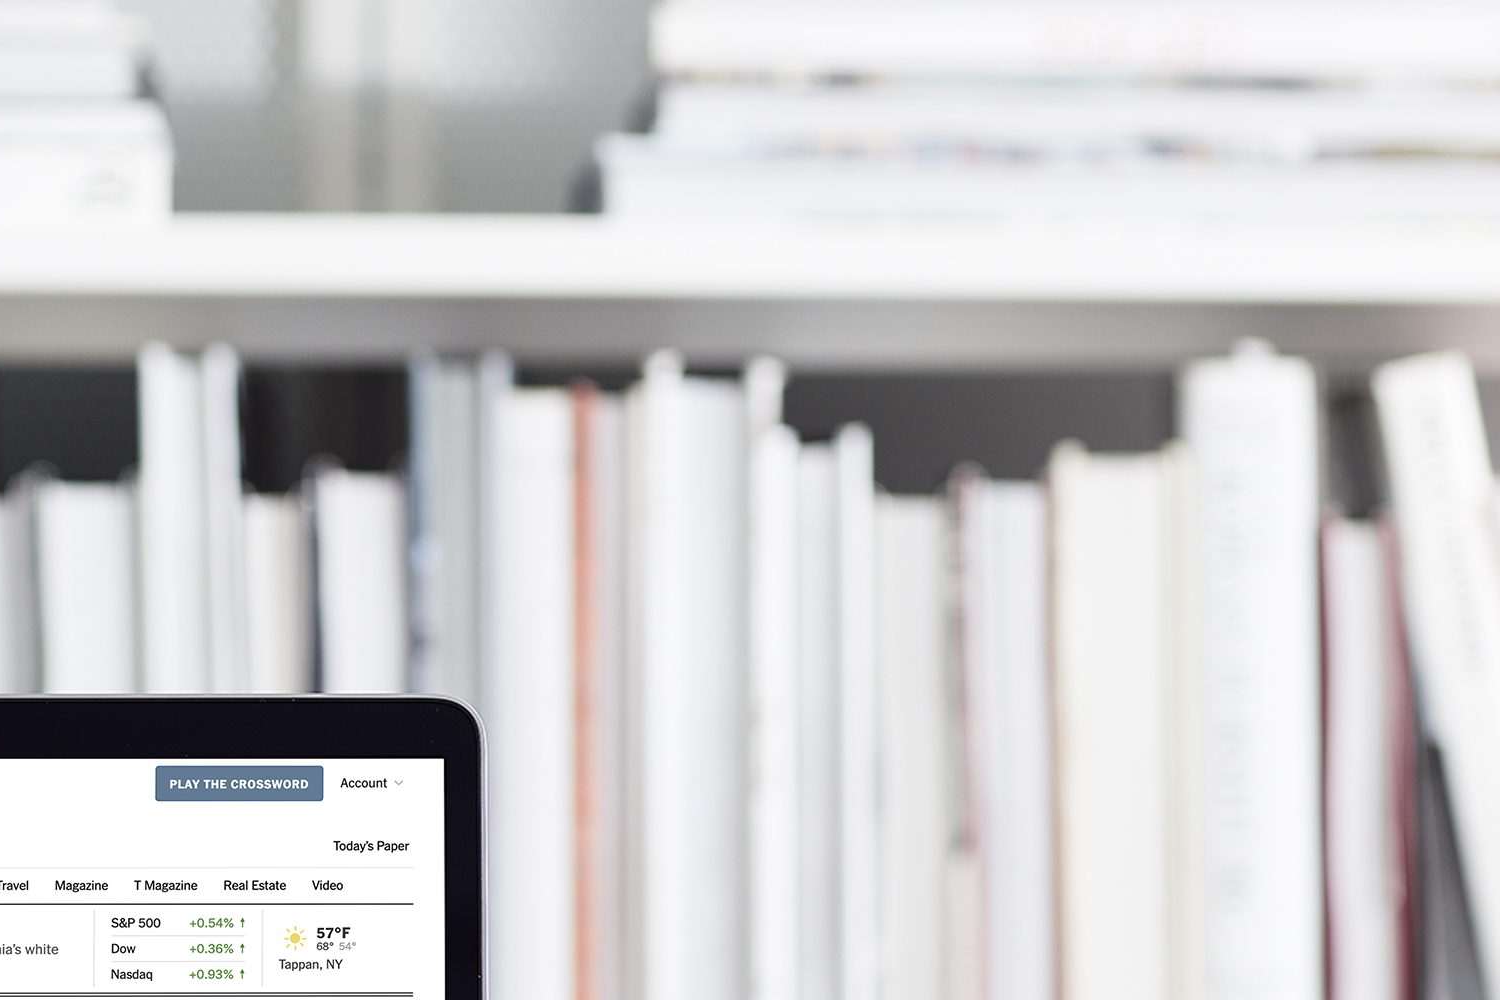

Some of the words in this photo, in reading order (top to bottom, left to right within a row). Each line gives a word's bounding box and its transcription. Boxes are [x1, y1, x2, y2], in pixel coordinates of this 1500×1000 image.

[170, 779, 200, 789] PLAY
[203, 779, 227, 789] THE
[231, 779, 309, 789] CROSSWORD
[340, 778, 387, 788] Account
[377, 840, 410, 853] Paper
[55, 880, 108, 893] Magazine
[134, 880, 141, 890] T
[145, 880, 198, 893] Magazine
[224, 880, 248, 891] Real
[252, 880, 287, 891] Estate
[312, 880, 343, 891] Video
[111, 917, 135, 928] S&P
[138, 918, 161, 928] 500
[190, 918, 234, 928] +0.54%
[111, 943, 136, 954] Dow
[189, 943, 234, 954] +0.36%
[279, 959, 322, 971] Tappan,
[326, 959, 343, 969] NY
[111, 969, 153, 981] Nasdaq
[189, 969, 234, 979] +0.93%
